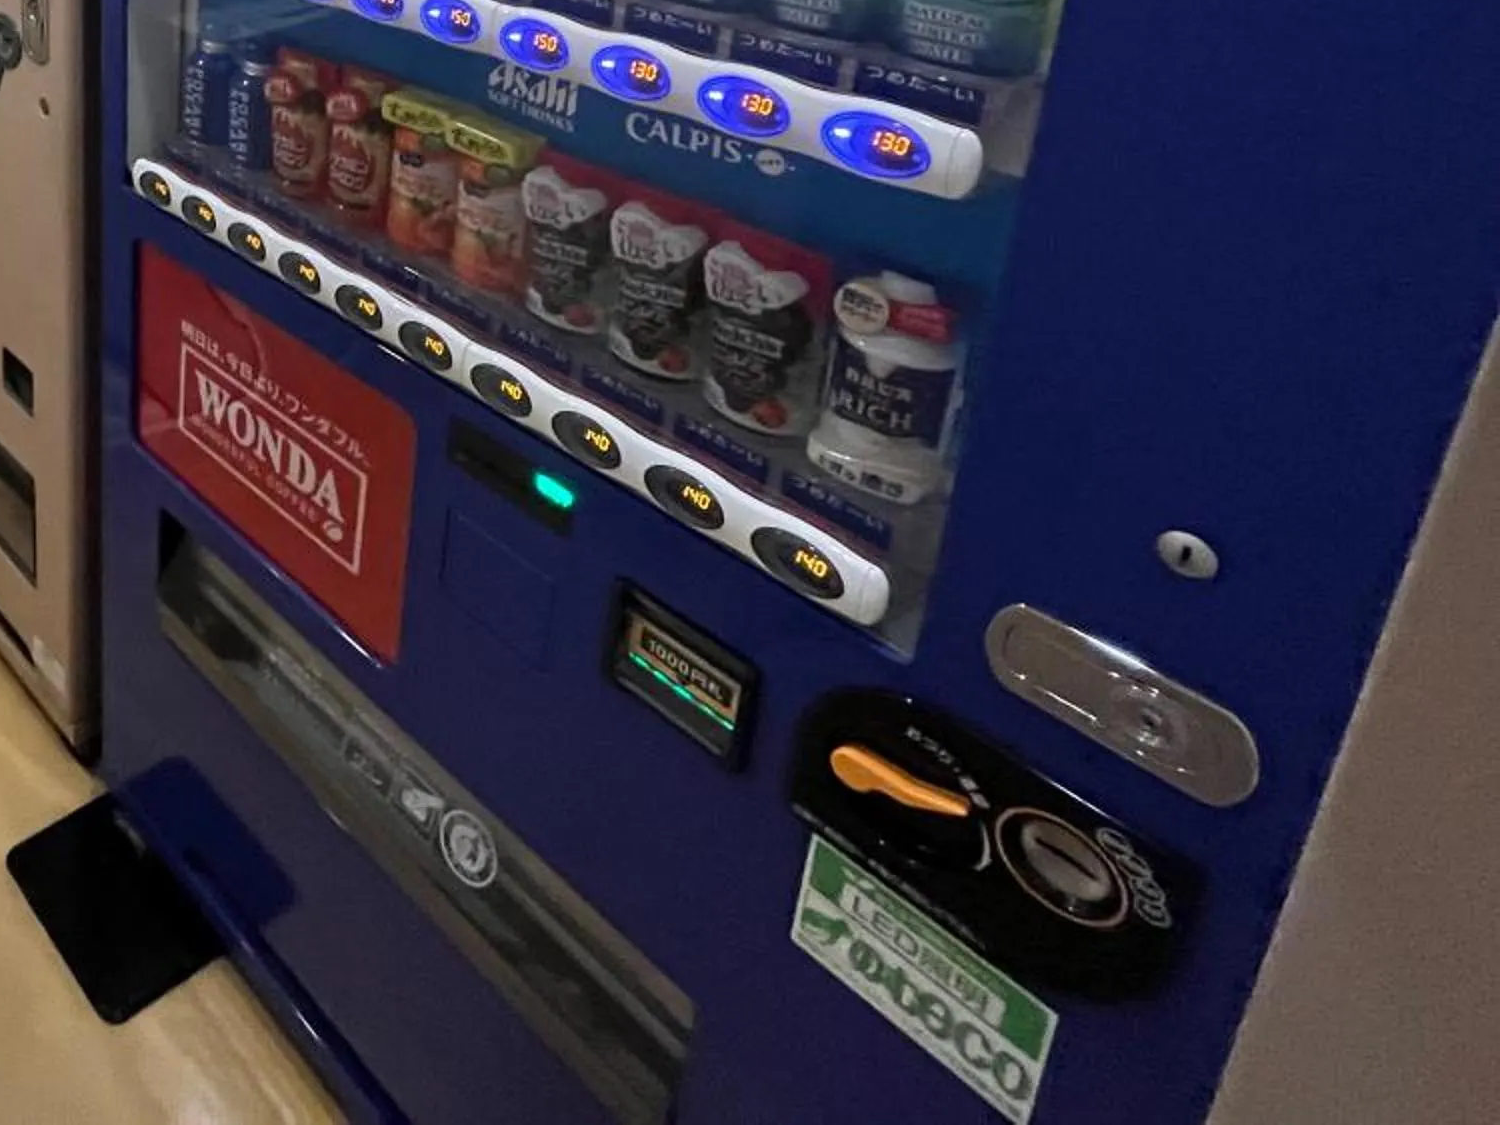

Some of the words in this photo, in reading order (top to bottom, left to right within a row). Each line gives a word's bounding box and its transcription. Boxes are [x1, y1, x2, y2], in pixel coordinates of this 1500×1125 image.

[451, 8, 472, 27] 150
[533, 33, 558, 53] 150
[630, 61, 658, 82] 130
[487, 63, 578, 117] Asahi
[741, 94, 774, 116] 130
[625, 111, 742, 164] CALPIS
[872, 131, 911, 156] 130
[500, 379, 522, 401] 140
[195, 367, 347, 522] WONDA
[584, 429, 610, 451] 140
[683, 486, 712, 511] 140
[795, 549, 828, 578] 140
